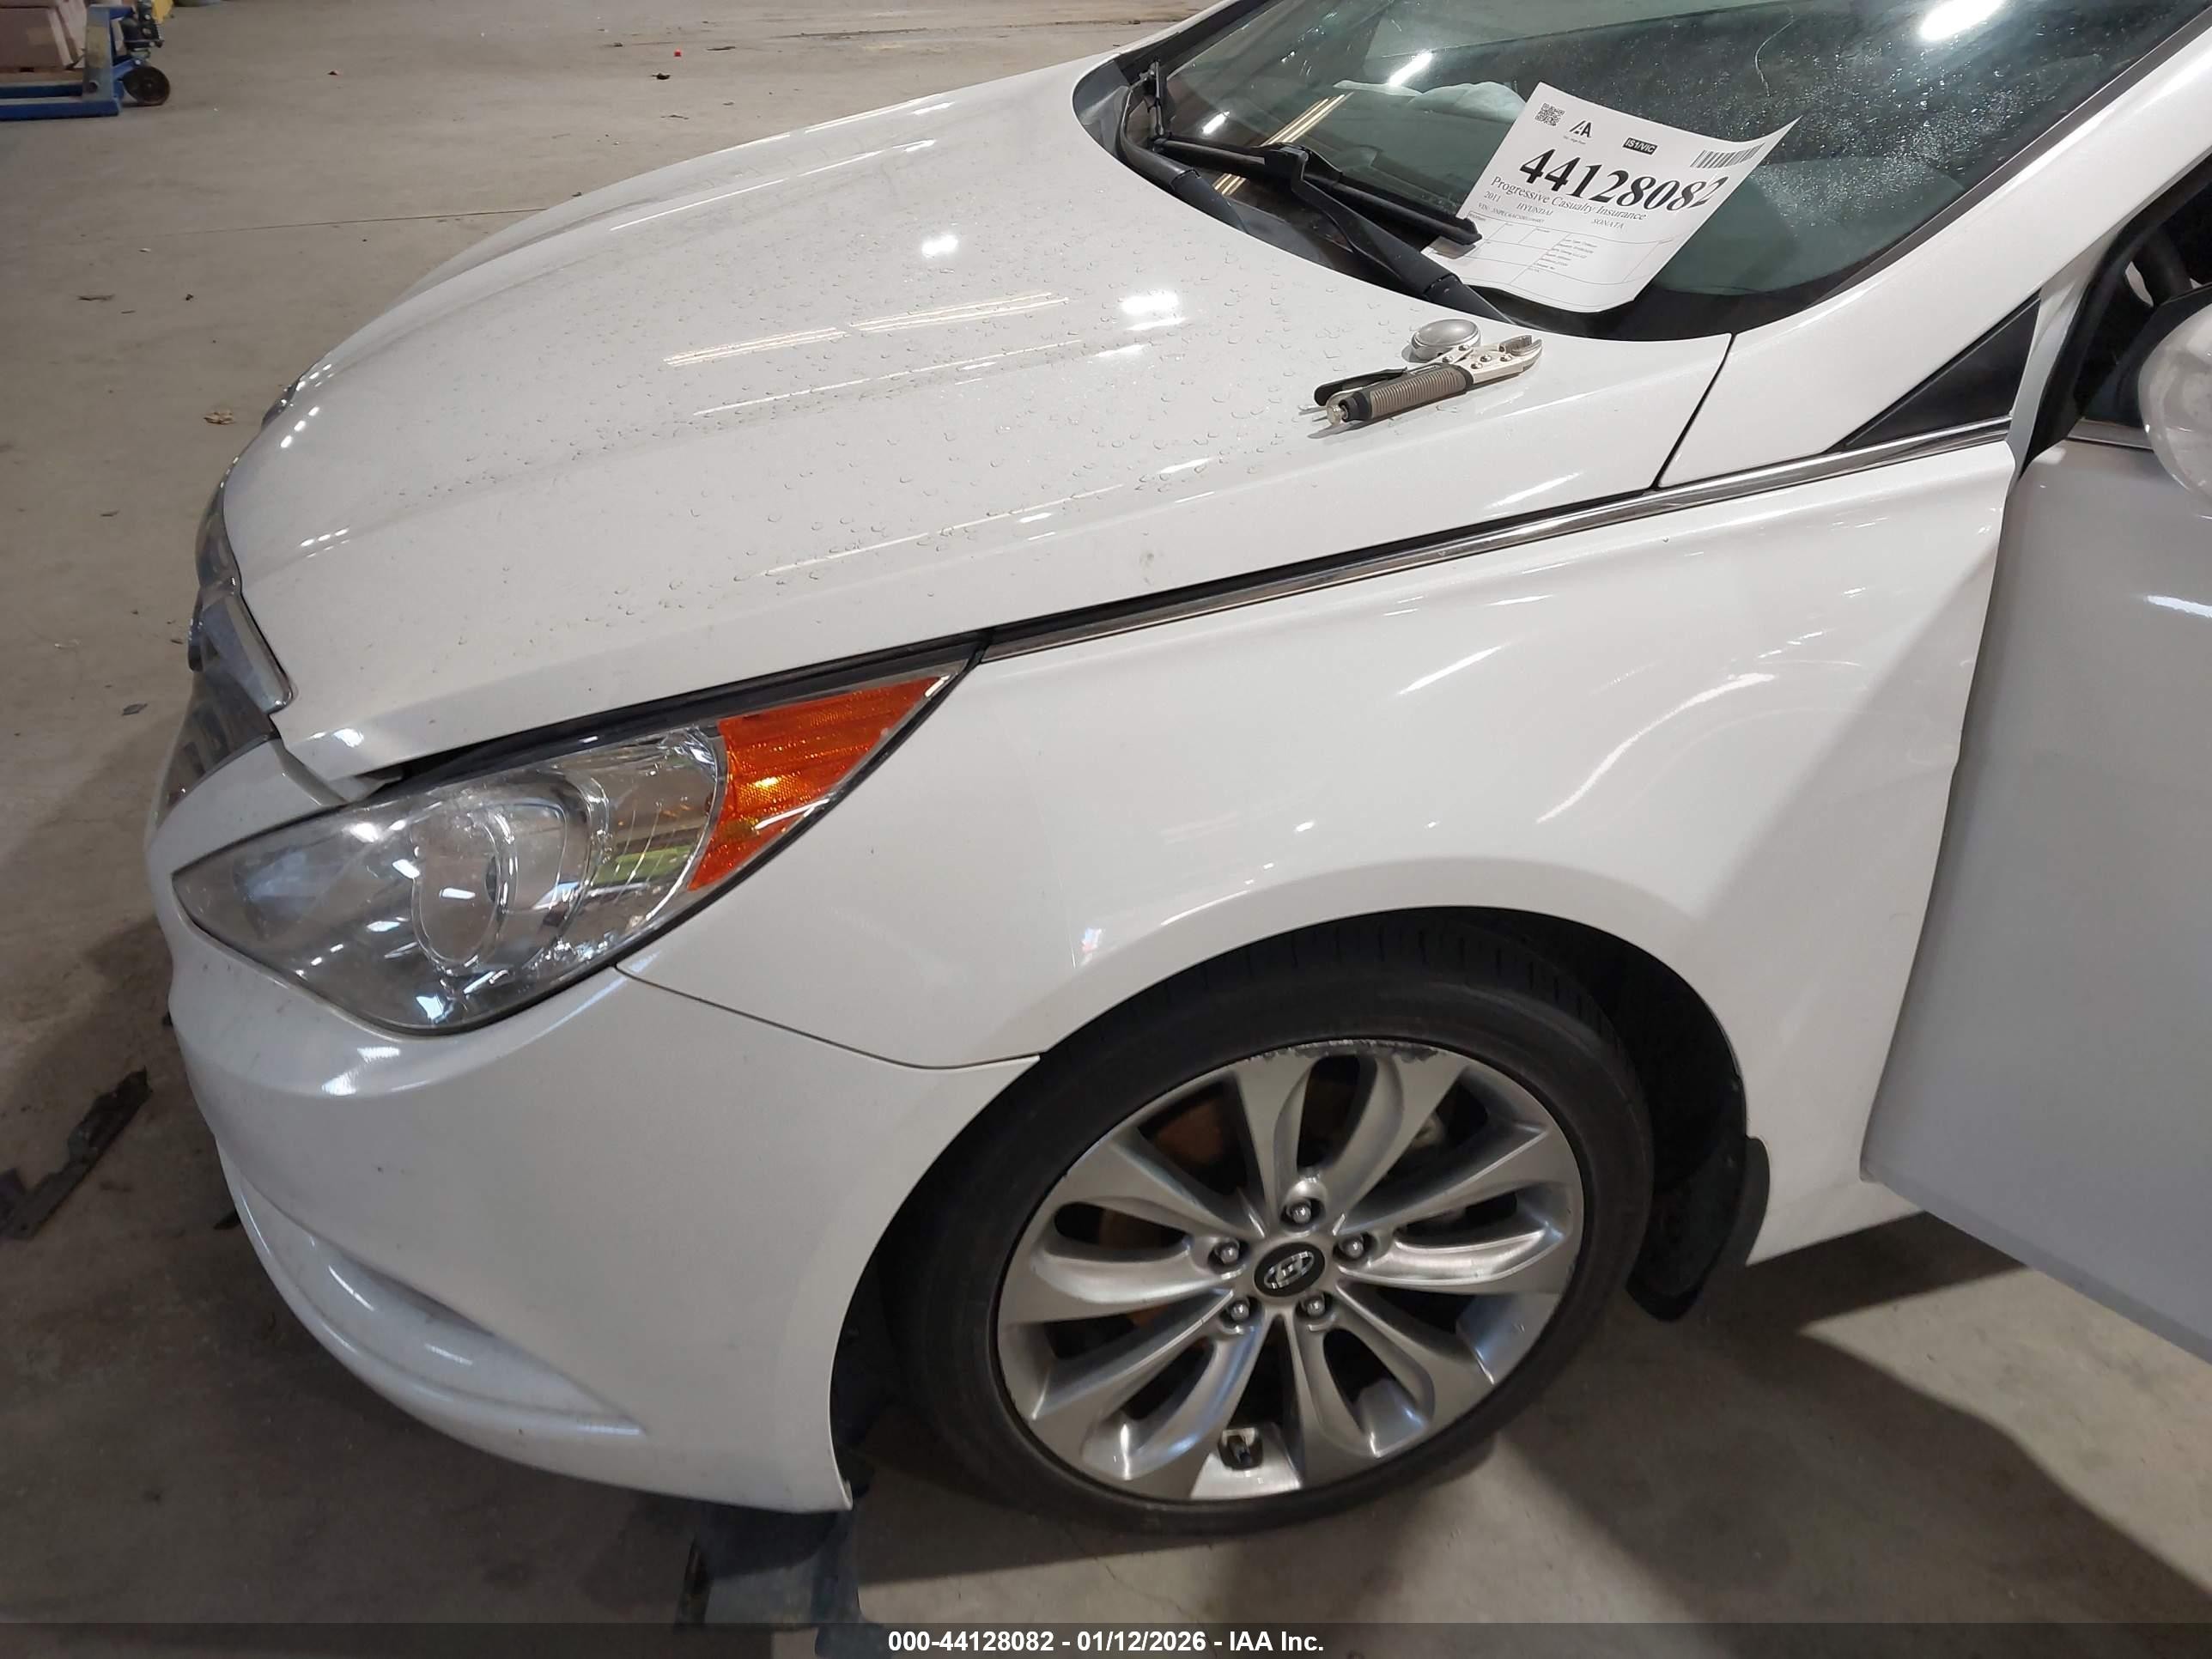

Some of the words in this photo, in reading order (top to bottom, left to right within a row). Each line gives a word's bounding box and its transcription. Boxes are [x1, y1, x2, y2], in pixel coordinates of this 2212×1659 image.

[1491, 176, 1550, 204] Progressive
[1551, 196, 1595, 214] Casualty
[1596, 205, 1647, 220] Insurance
[1519, 149, 1729, 211] 44128082
[1484, 191, 1501, 202] 2011
[1516, 202, 1553, 216] HYUNDAI
[1592, 218, 1624, 229] SONATA
